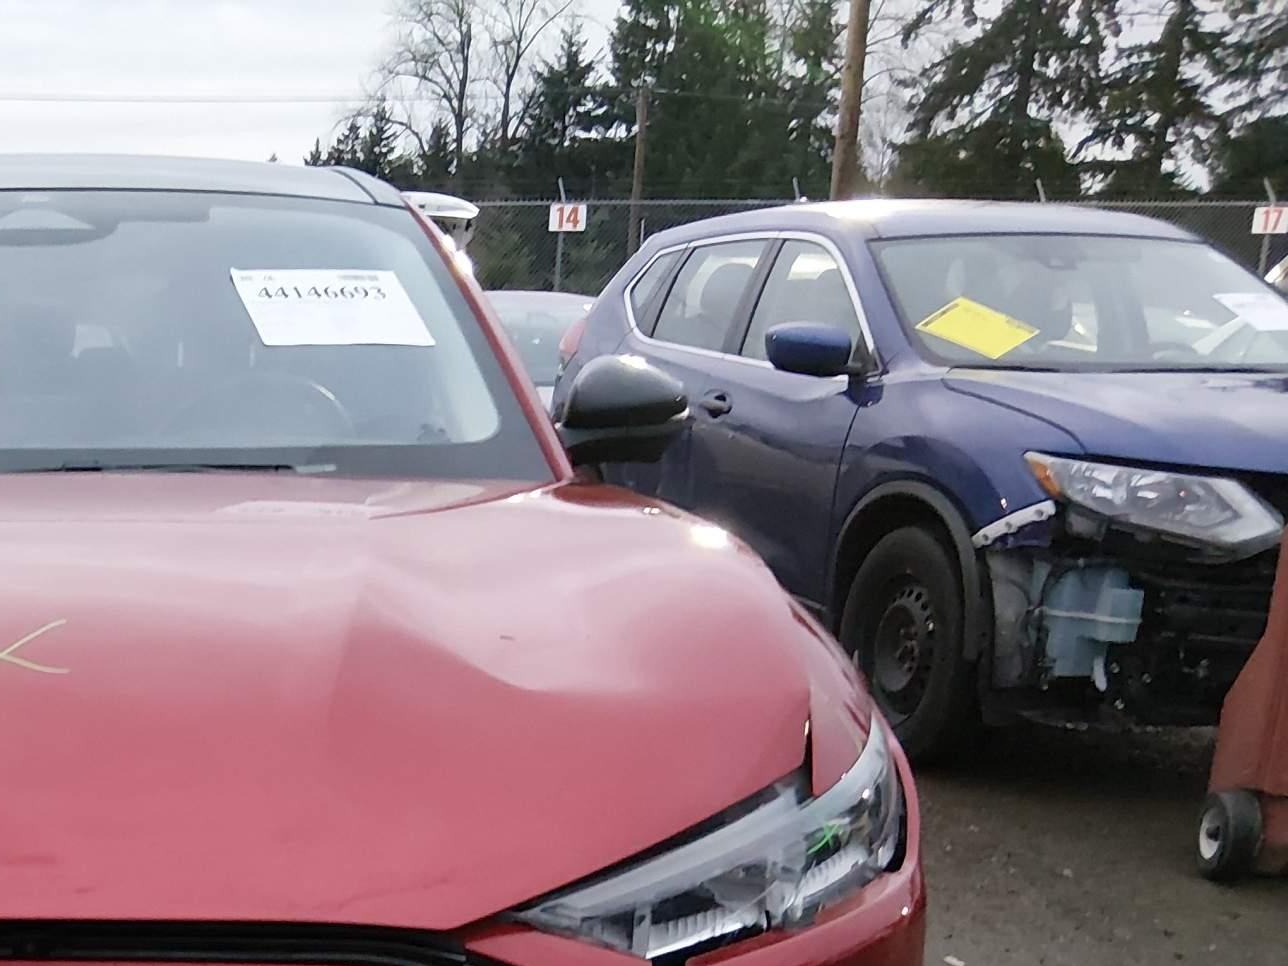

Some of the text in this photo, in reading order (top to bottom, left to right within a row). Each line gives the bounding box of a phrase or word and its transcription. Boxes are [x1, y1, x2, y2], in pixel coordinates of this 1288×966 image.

[557, 206, 580, 230] 14
[1263, 208, 1283, 231] 17
[258, 285, 387, 299] 44146693
